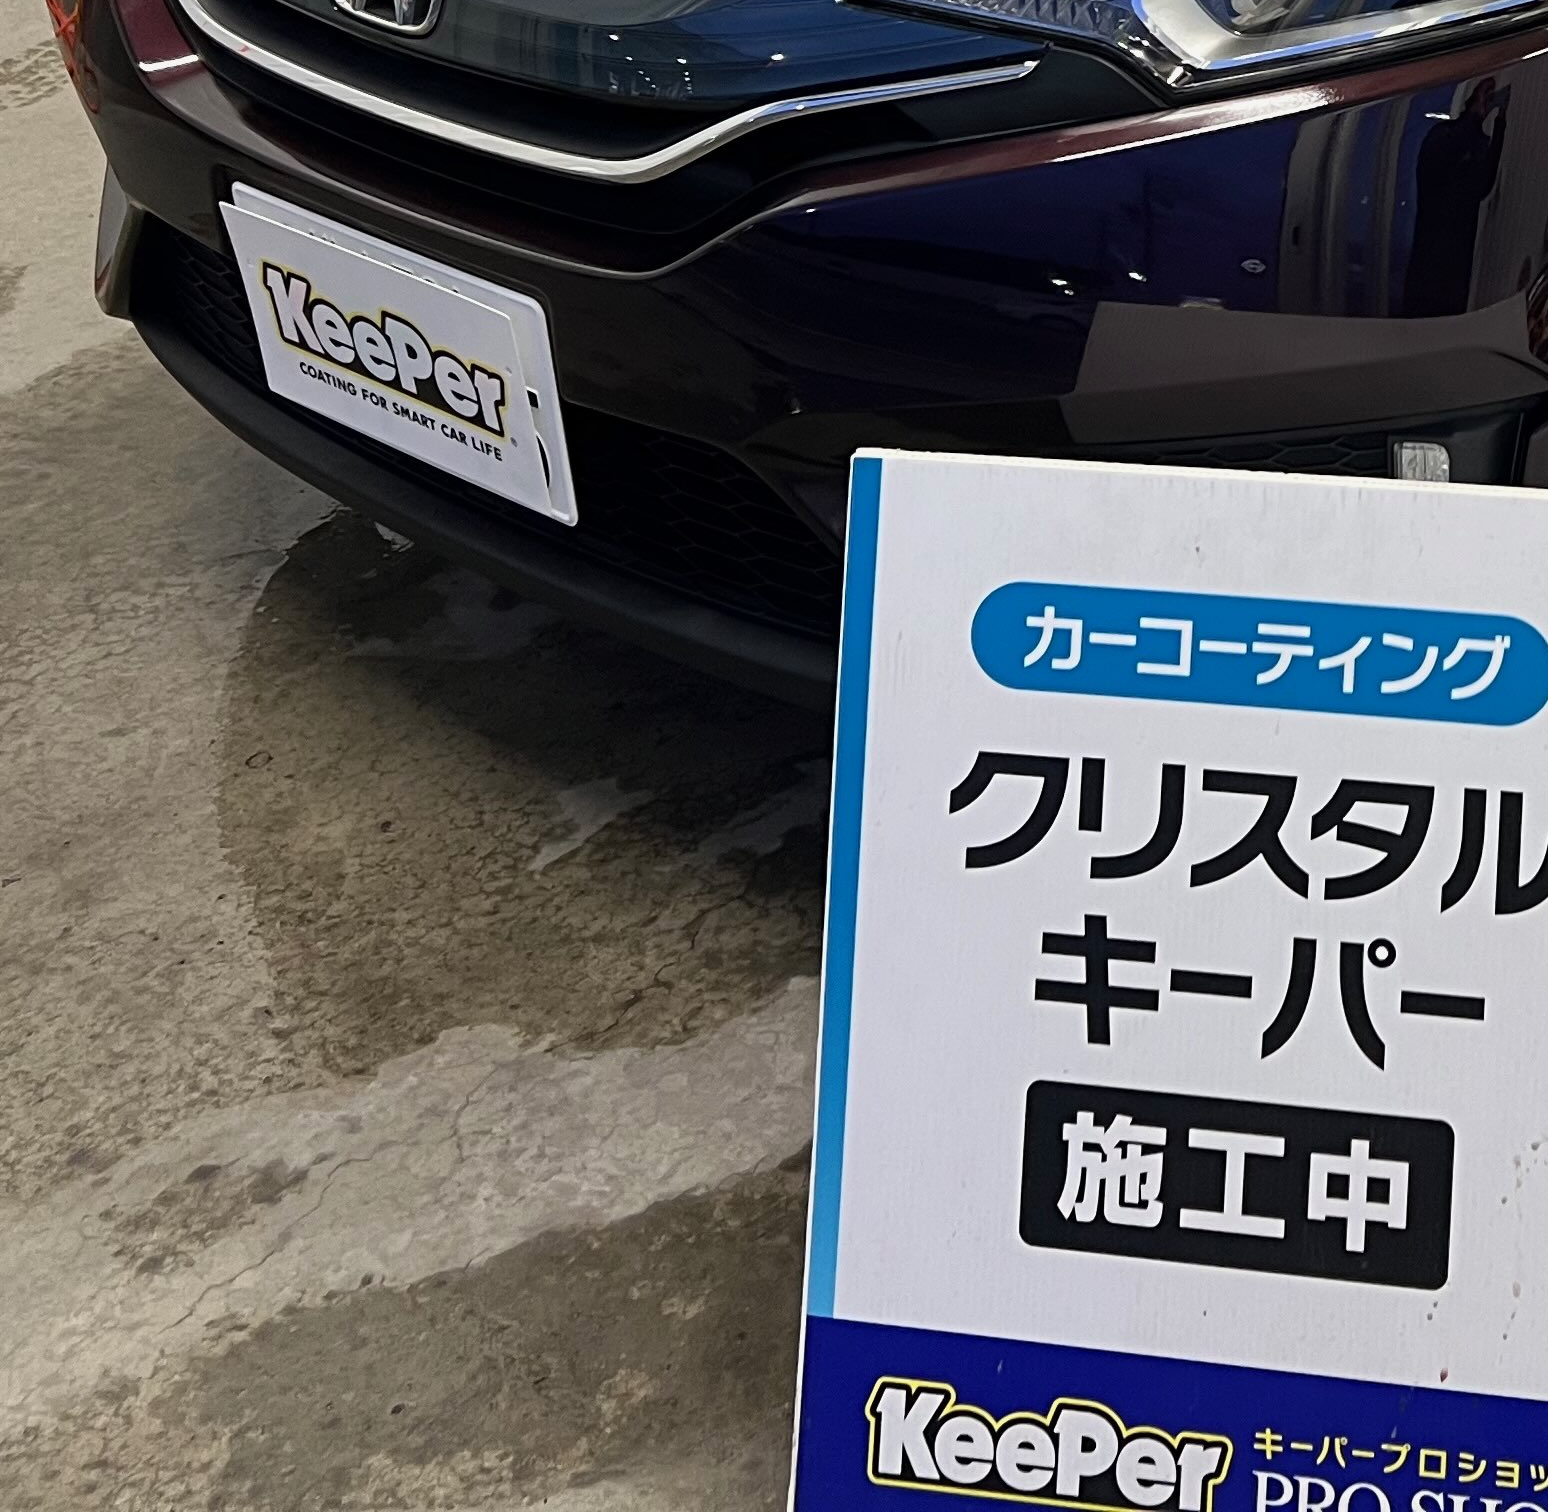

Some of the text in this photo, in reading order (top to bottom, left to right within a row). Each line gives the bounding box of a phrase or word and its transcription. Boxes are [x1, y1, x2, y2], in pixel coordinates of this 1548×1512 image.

[262, 261, 505, 437] KeePer
[300, 361, 503, 462] COATING FOR SMART CAR LIFE
[1022, 604, 1511, 700] カーコーティング
[1034, 913, 1485, 1071] キーパー
[1057, 1110, 1410, 1253] 施工中
[868, 1378, 1231, 1512] KeePer
[1252, 1470, 1392, 1512] PRO
